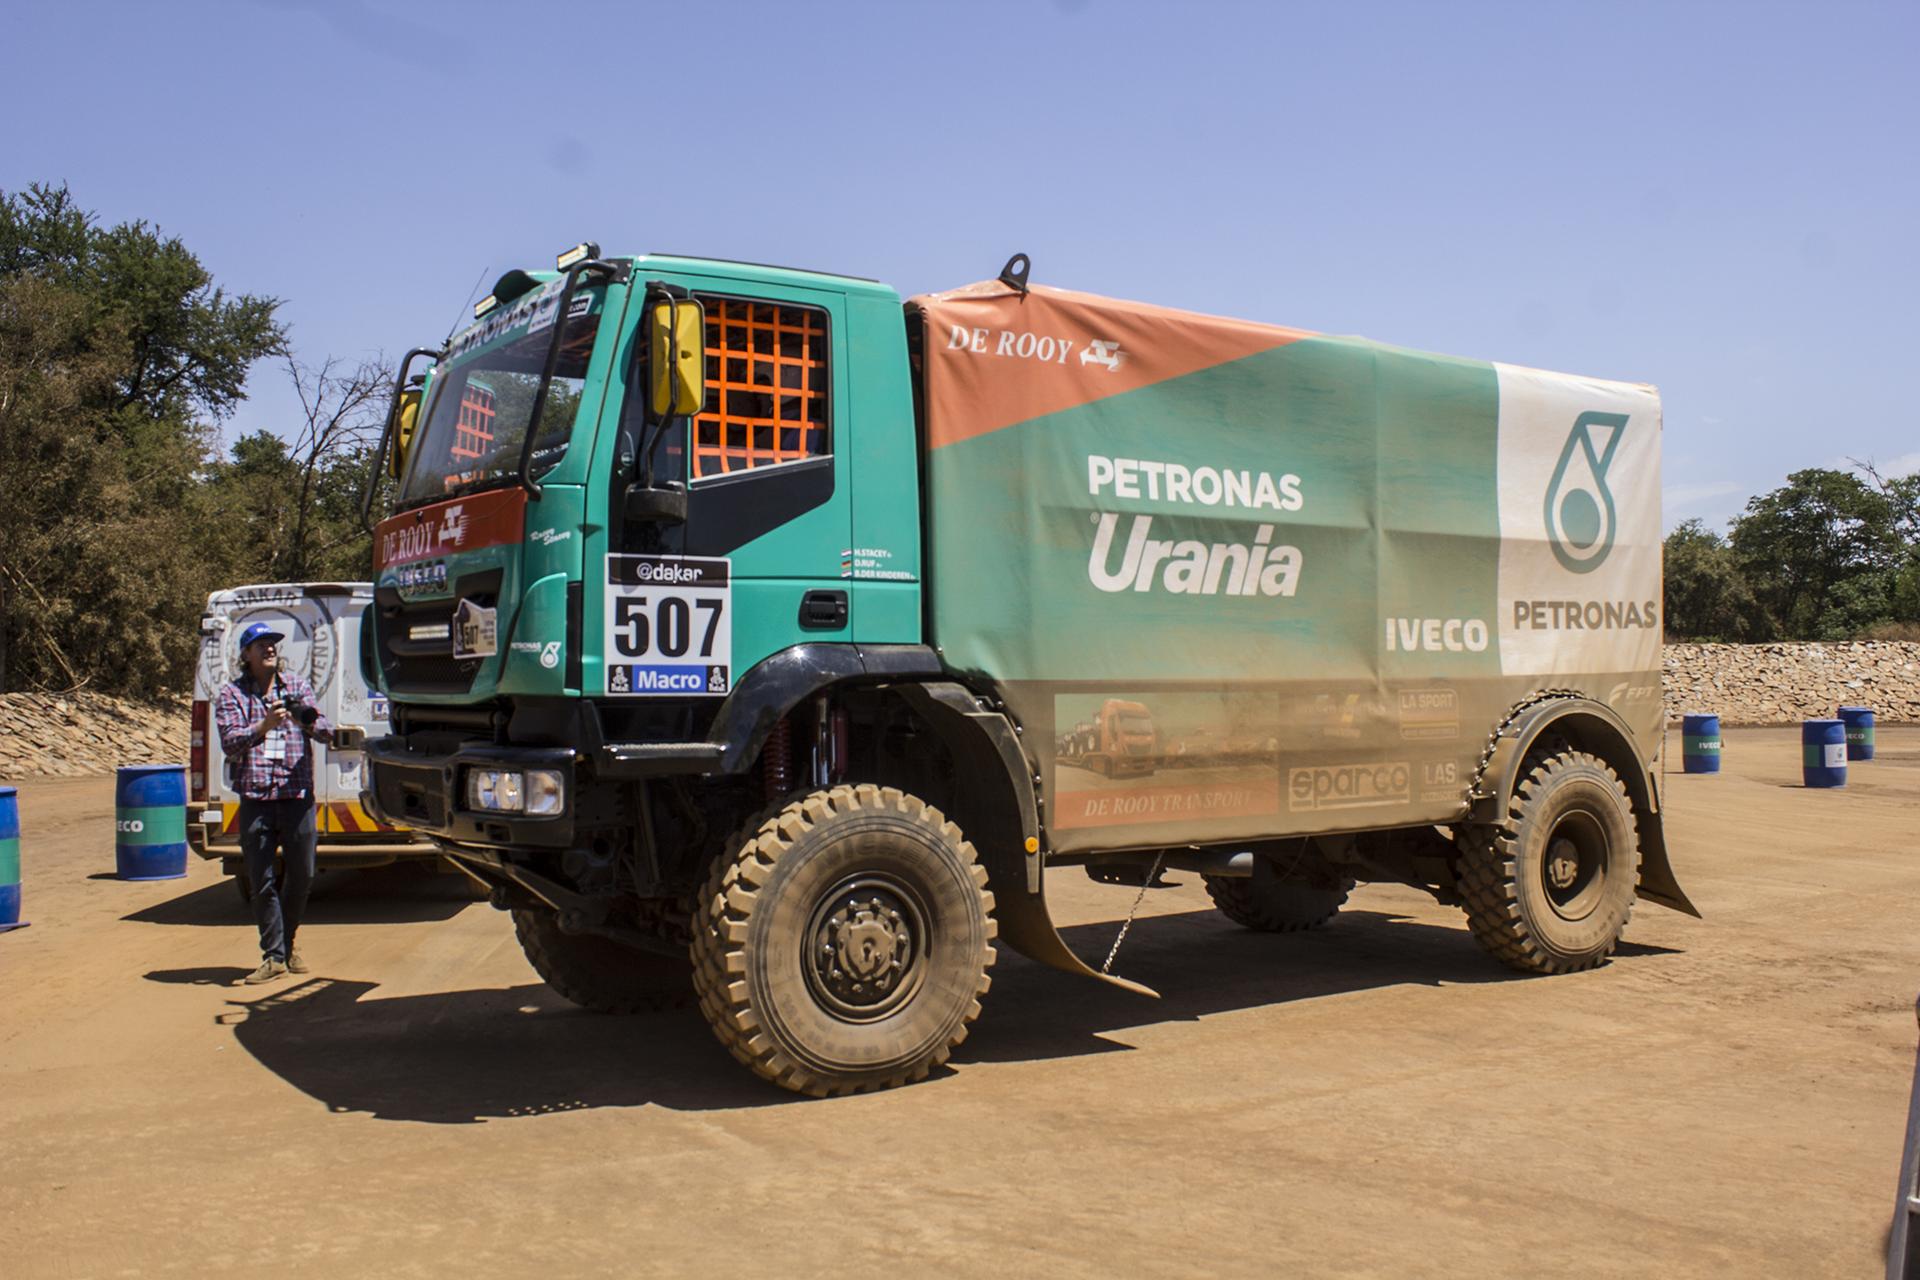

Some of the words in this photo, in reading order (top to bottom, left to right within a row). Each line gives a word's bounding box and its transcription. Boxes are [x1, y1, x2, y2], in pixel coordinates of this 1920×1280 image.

[948, 324, 989, 354] DE
[996, 331, 1073, 364] ROOY
[1088, 455, 1303, 511] PETRONAS
[382, 531, 397, 563] DE
[399, 521, 434, 559] ROOY
[1088, 512, 1303, 596] Urania
[636, 562, 703, 581] @dakar
[615, 596, 723, 657] 507
[1513, 600, 1657, 630] PETRONAS
[1385, 618, 1489, 652] IVECO
[638, 671, 701, 689] Macro
[1292, 766, 1409, 808] sparco
[1425, 763, 1456, 784] LAS
[1085, 799, 1109, 816] DE
[1113, 795, 1156, 815] ROOY
[1163, 791, 1252, 811] TRANSPORT
